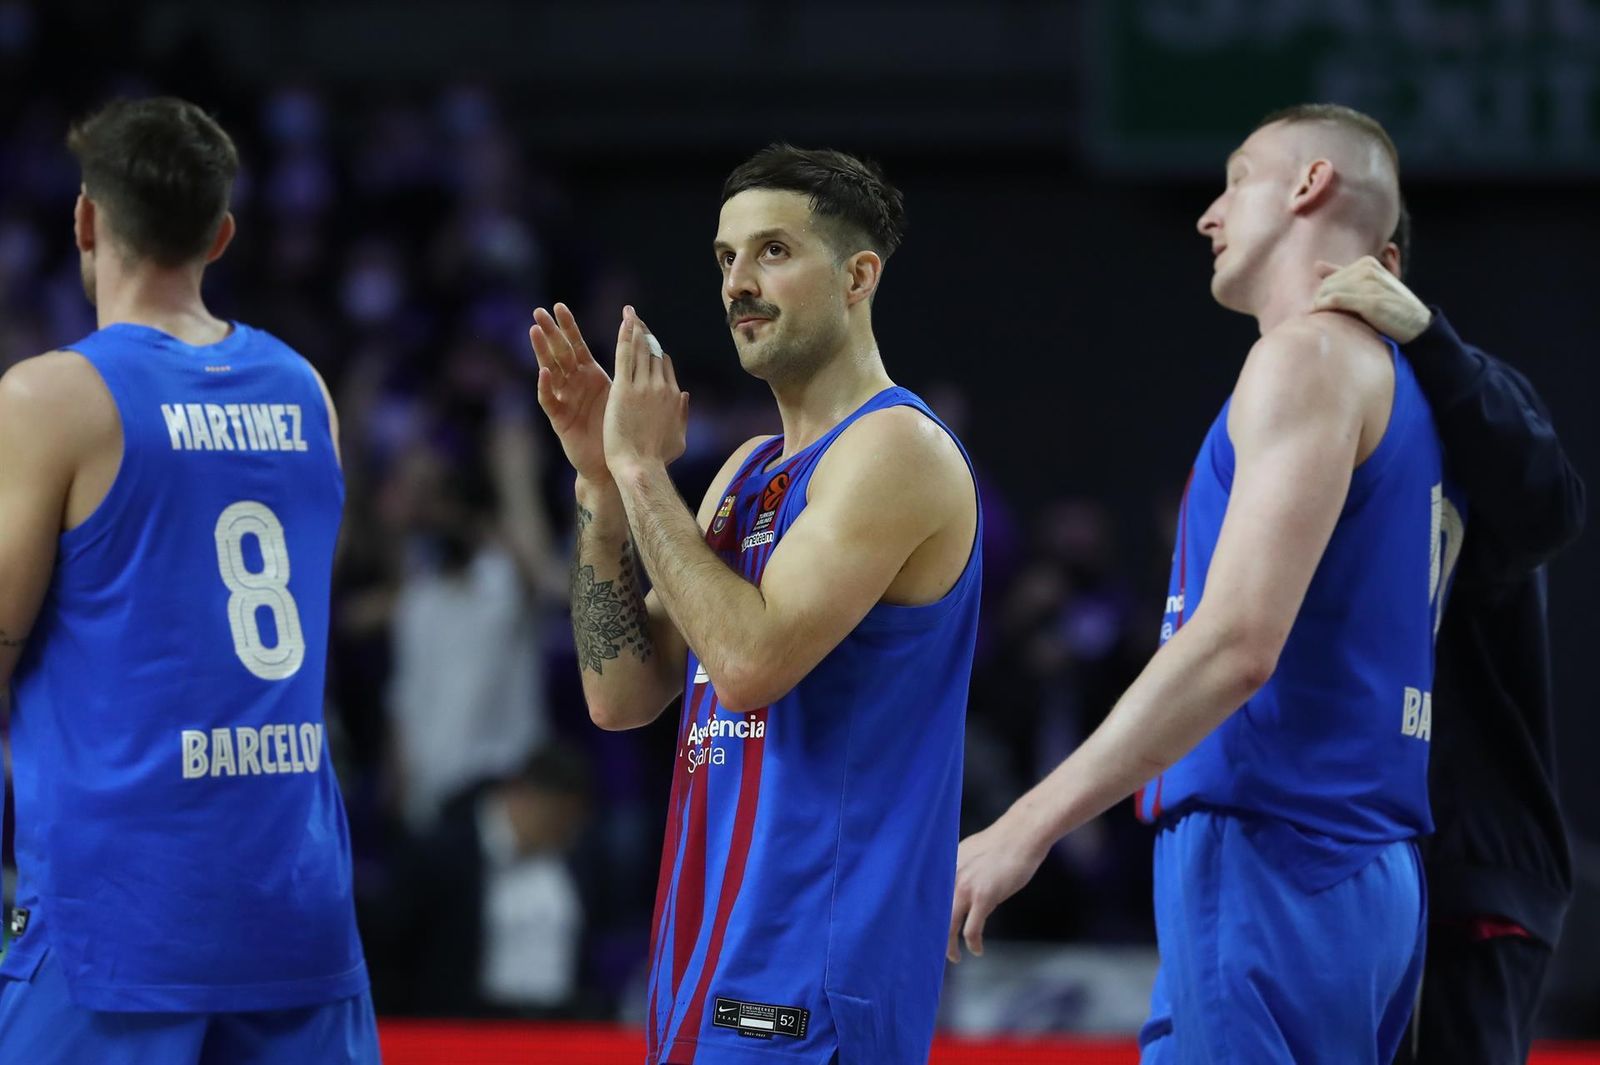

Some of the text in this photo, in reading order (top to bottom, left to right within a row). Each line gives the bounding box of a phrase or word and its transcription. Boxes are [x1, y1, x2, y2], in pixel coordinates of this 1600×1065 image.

[160, 403, 309, 453] MARTINEZ
[214, 500, 306, 681] 8
[717, 1014, 737, 1023] TEAM
[779, 1014, 796, 1028] 52
